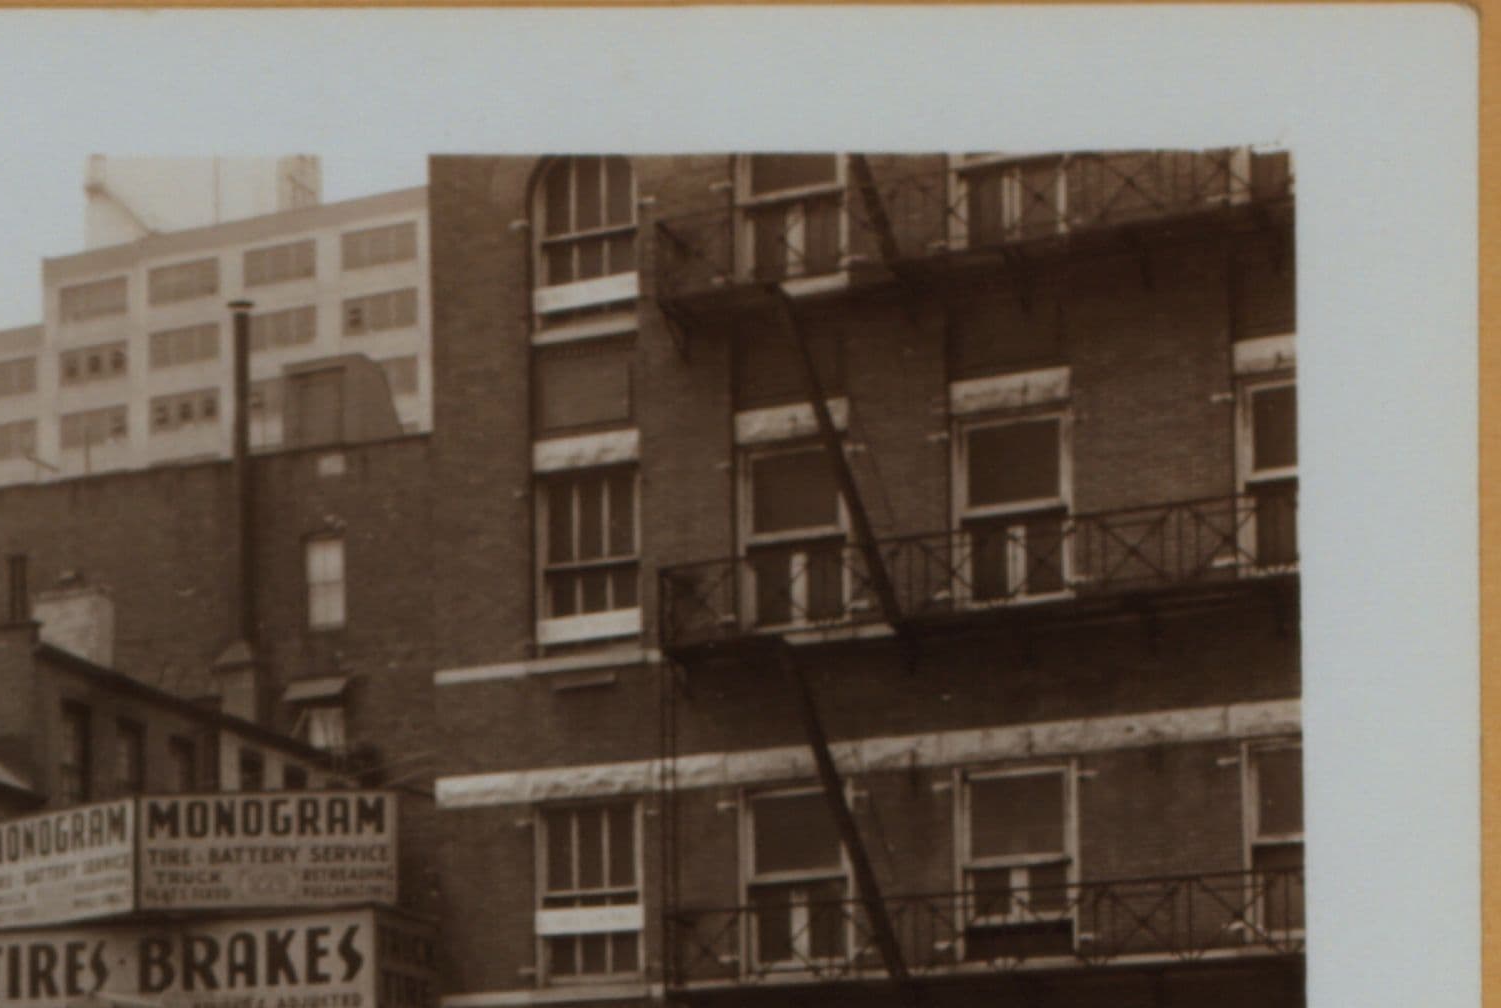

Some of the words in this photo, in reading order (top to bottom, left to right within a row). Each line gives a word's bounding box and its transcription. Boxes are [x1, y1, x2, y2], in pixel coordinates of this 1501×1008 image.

[146, 796, 385, 839] MONOGRAM
[147, 848, 190, 865] TIRE
[208, 846, 298, 864] BATTERY
[309, 845, 389, 863] SERVICE
[153, 870, 221, 885] TRUCK
[140, 925, 364, 993] BRAKES
